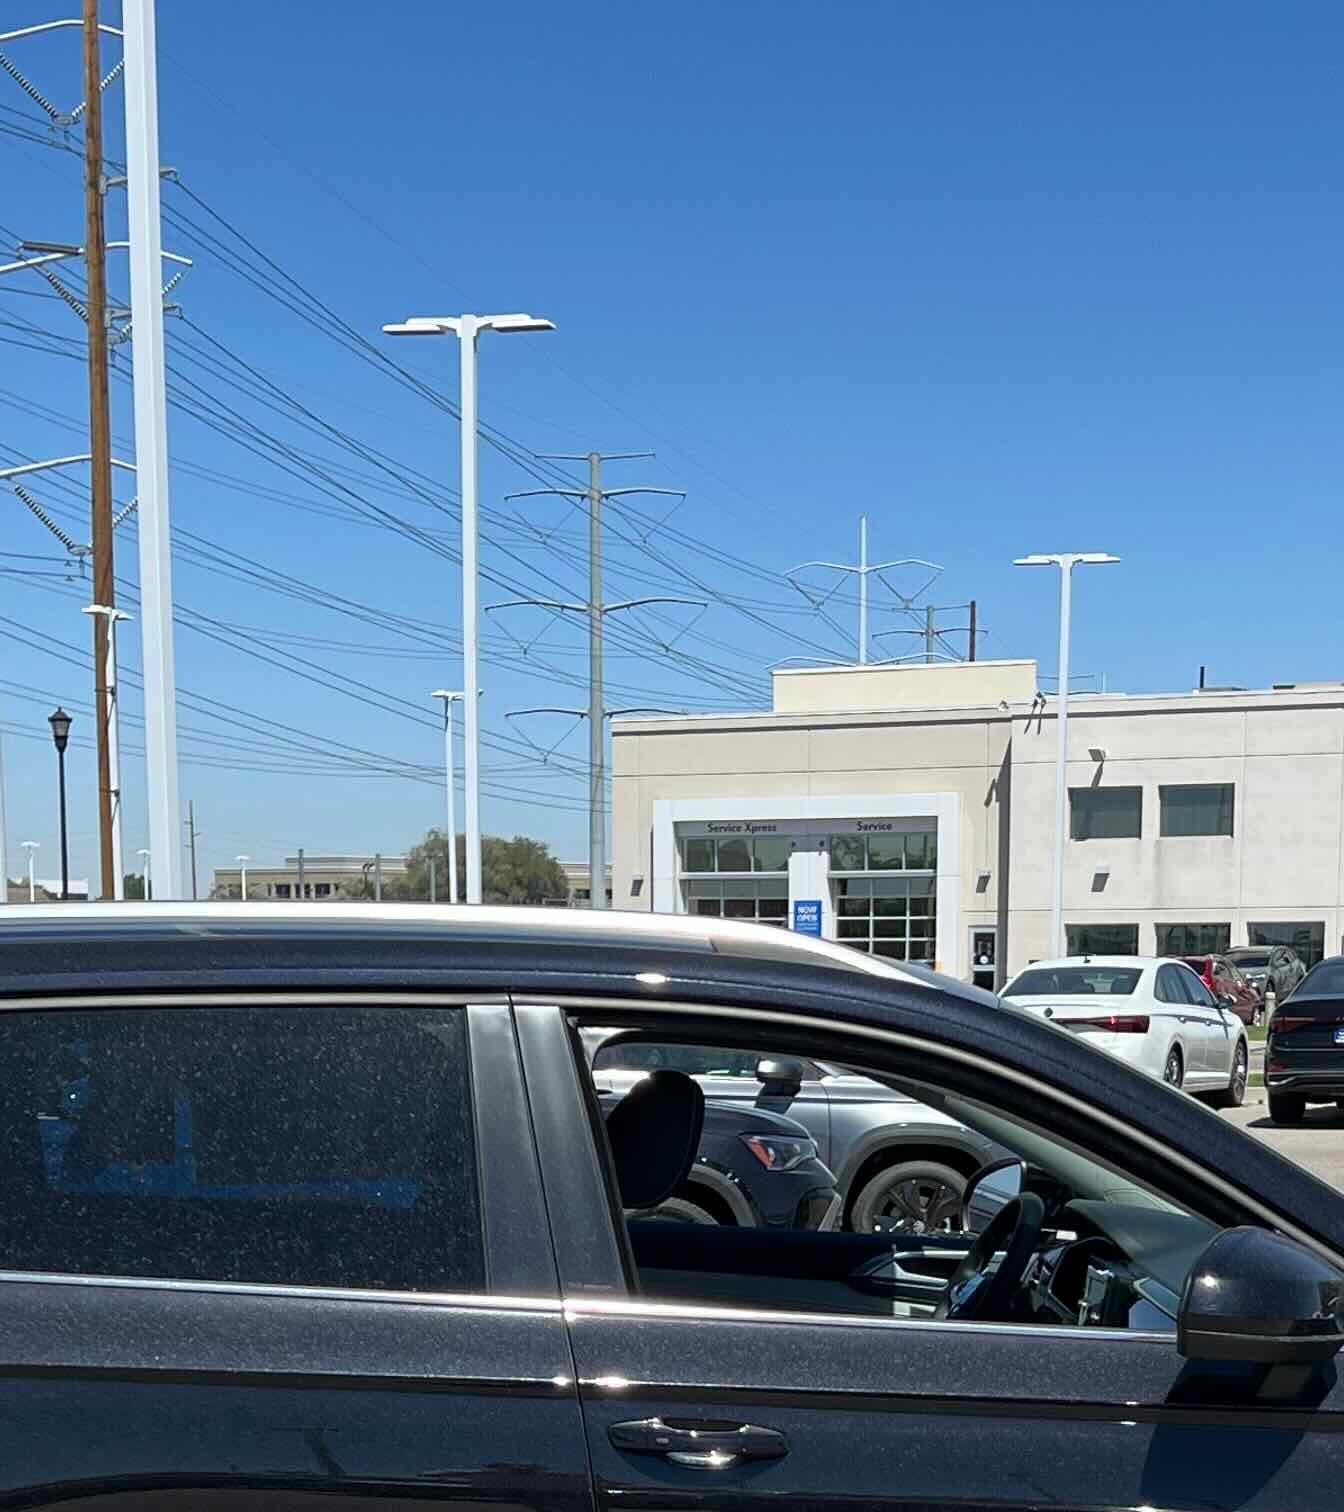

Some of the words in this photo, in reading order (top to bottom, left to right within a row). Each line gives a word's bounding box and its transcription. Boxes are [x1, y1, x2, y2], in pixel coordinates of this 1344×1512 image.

[707, 822, 742, 833] Service
[744, 822, 777, 834] Xpress
[857, 820, 892, 831] Service
